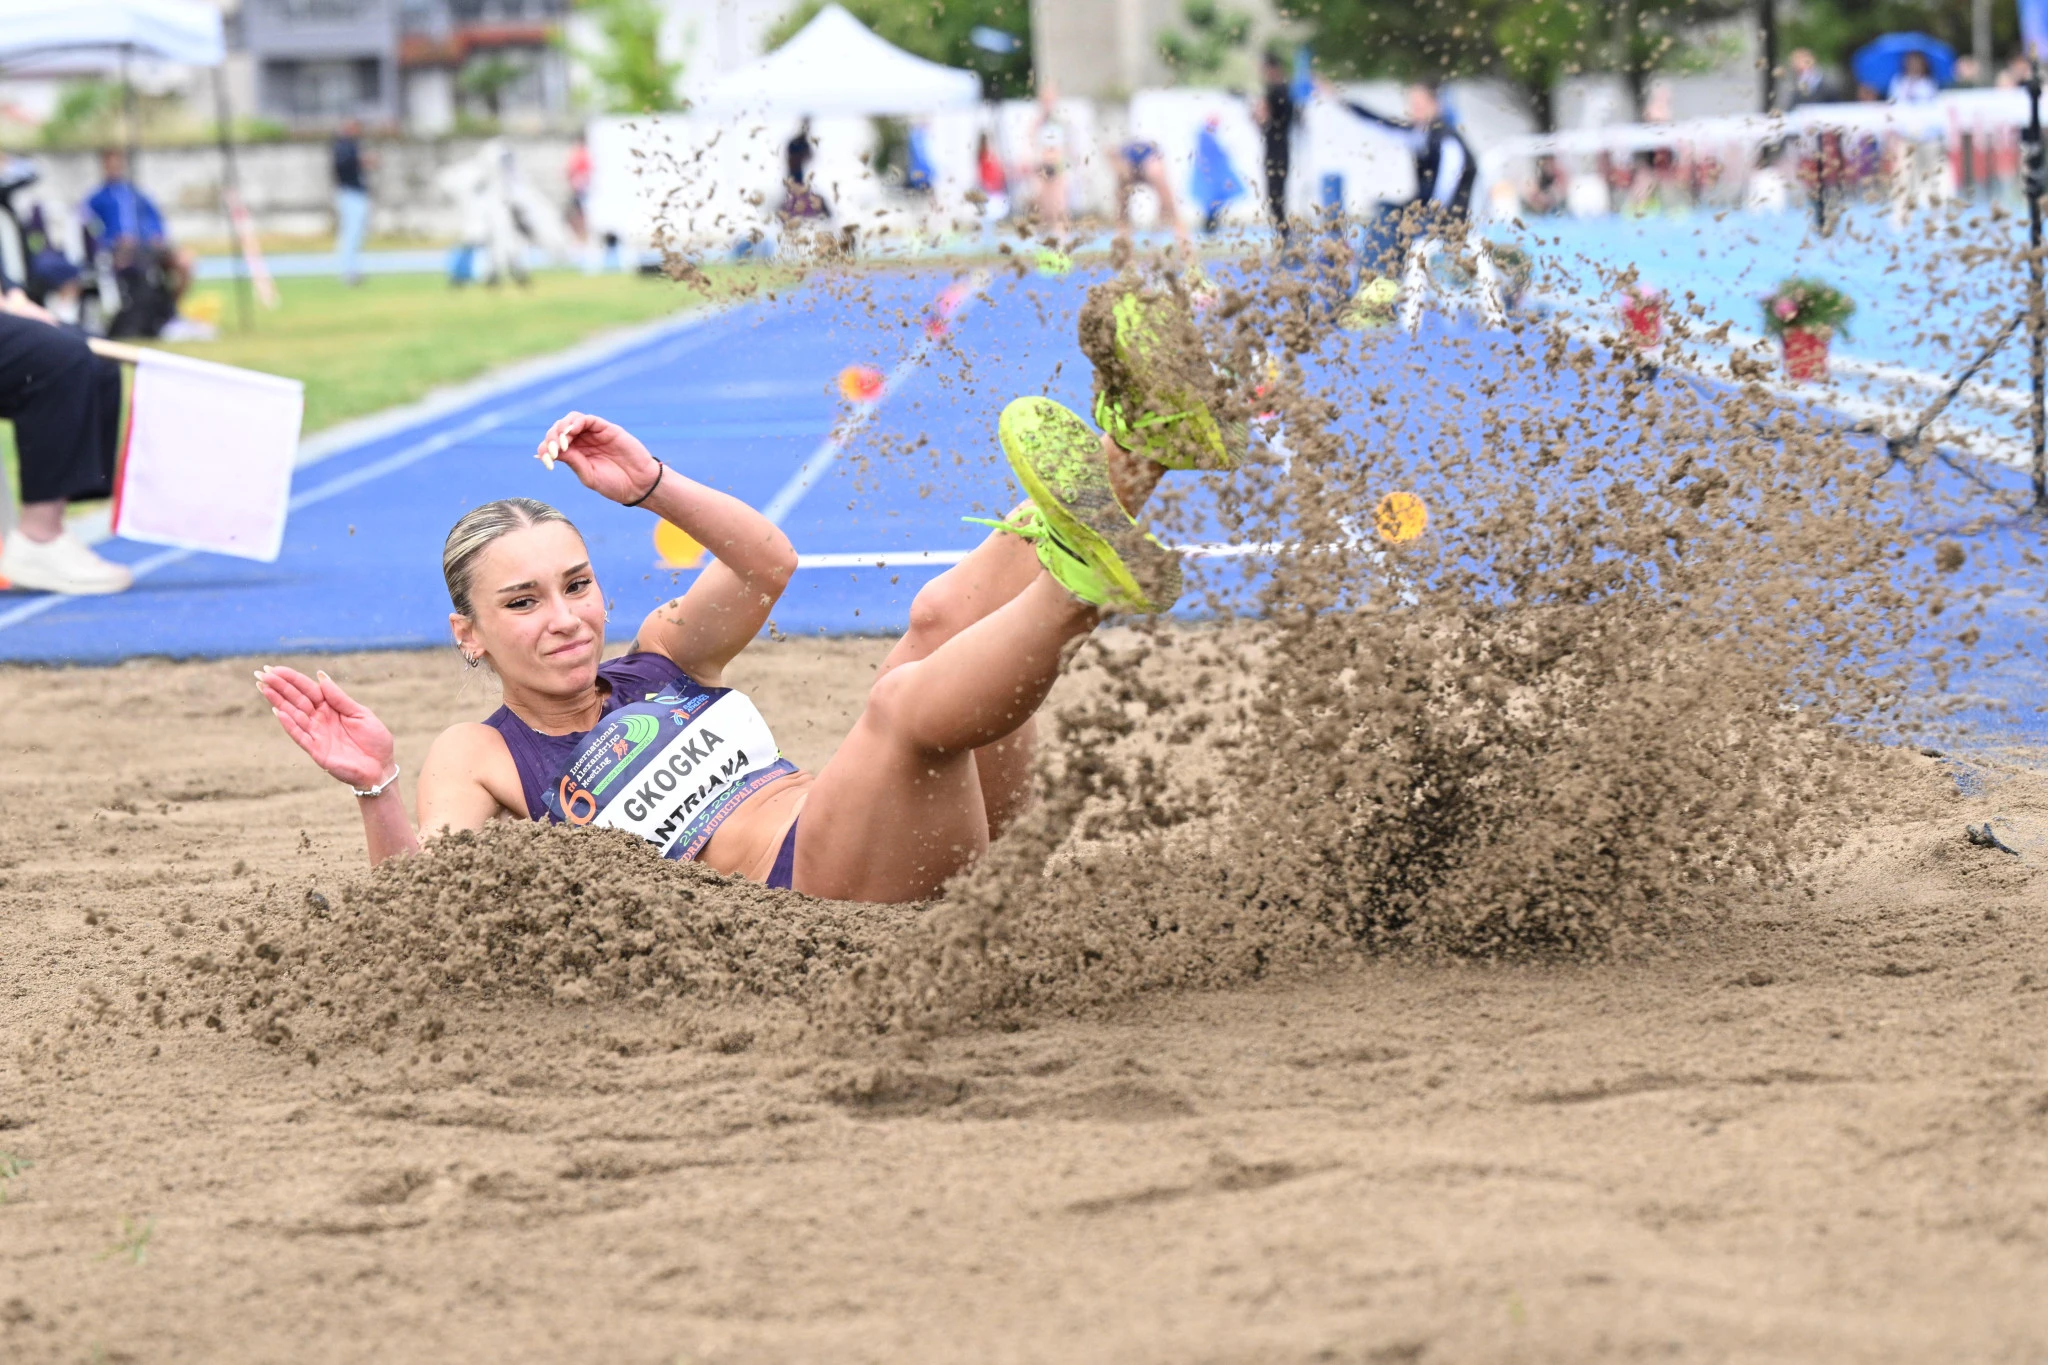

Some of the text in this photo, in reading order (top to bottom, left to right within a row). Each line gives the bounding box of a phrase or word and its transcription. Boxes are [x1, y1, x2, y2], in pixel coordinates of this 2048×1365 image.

[570, 722, 619, 776] International
[575, 734, 620, 782] Alexandrino
[581, 756, 612, 788] Meeting
[623, 727, 725, 821] GKOGKA
[680, 768, 787, 862] DRIA MUNICIPAL STADIUM
